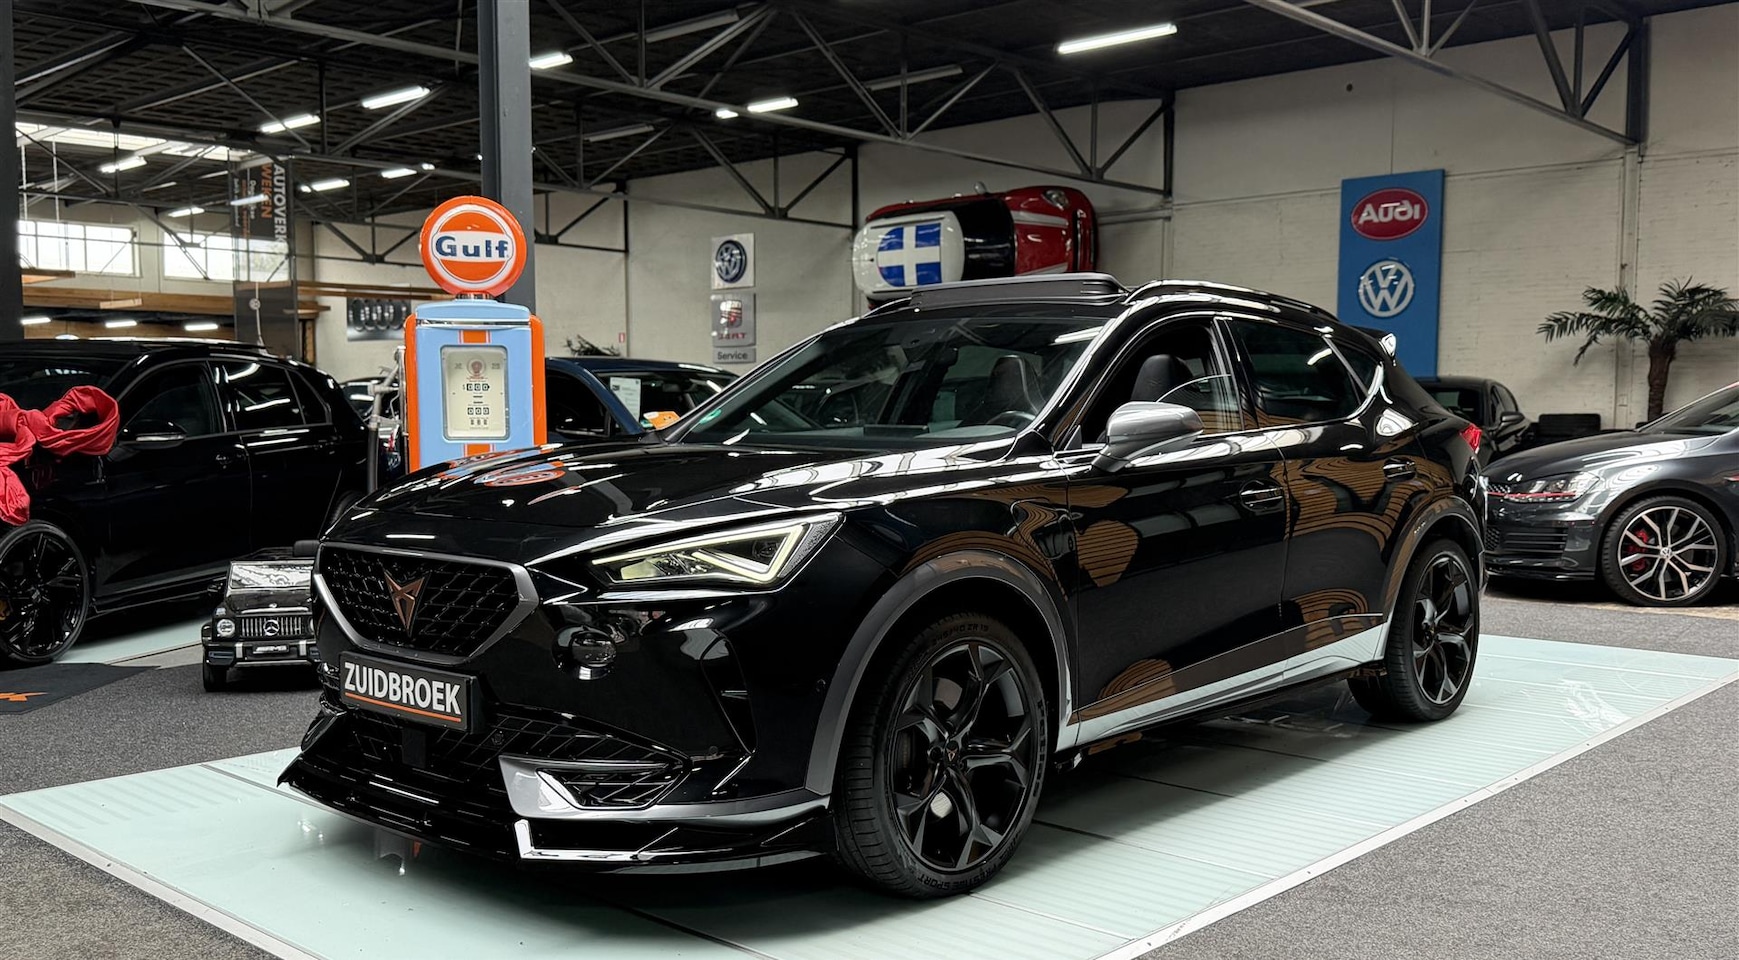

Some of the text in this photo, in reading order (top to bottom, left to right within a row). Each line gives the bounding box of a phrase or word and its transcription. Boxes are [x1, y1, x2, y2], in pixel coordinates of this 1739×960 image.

[435, 235, 509, 258] Gulf
[717, 351, 749, 361] Service
[345, 662, 461, 715] ZUIDBROEK
